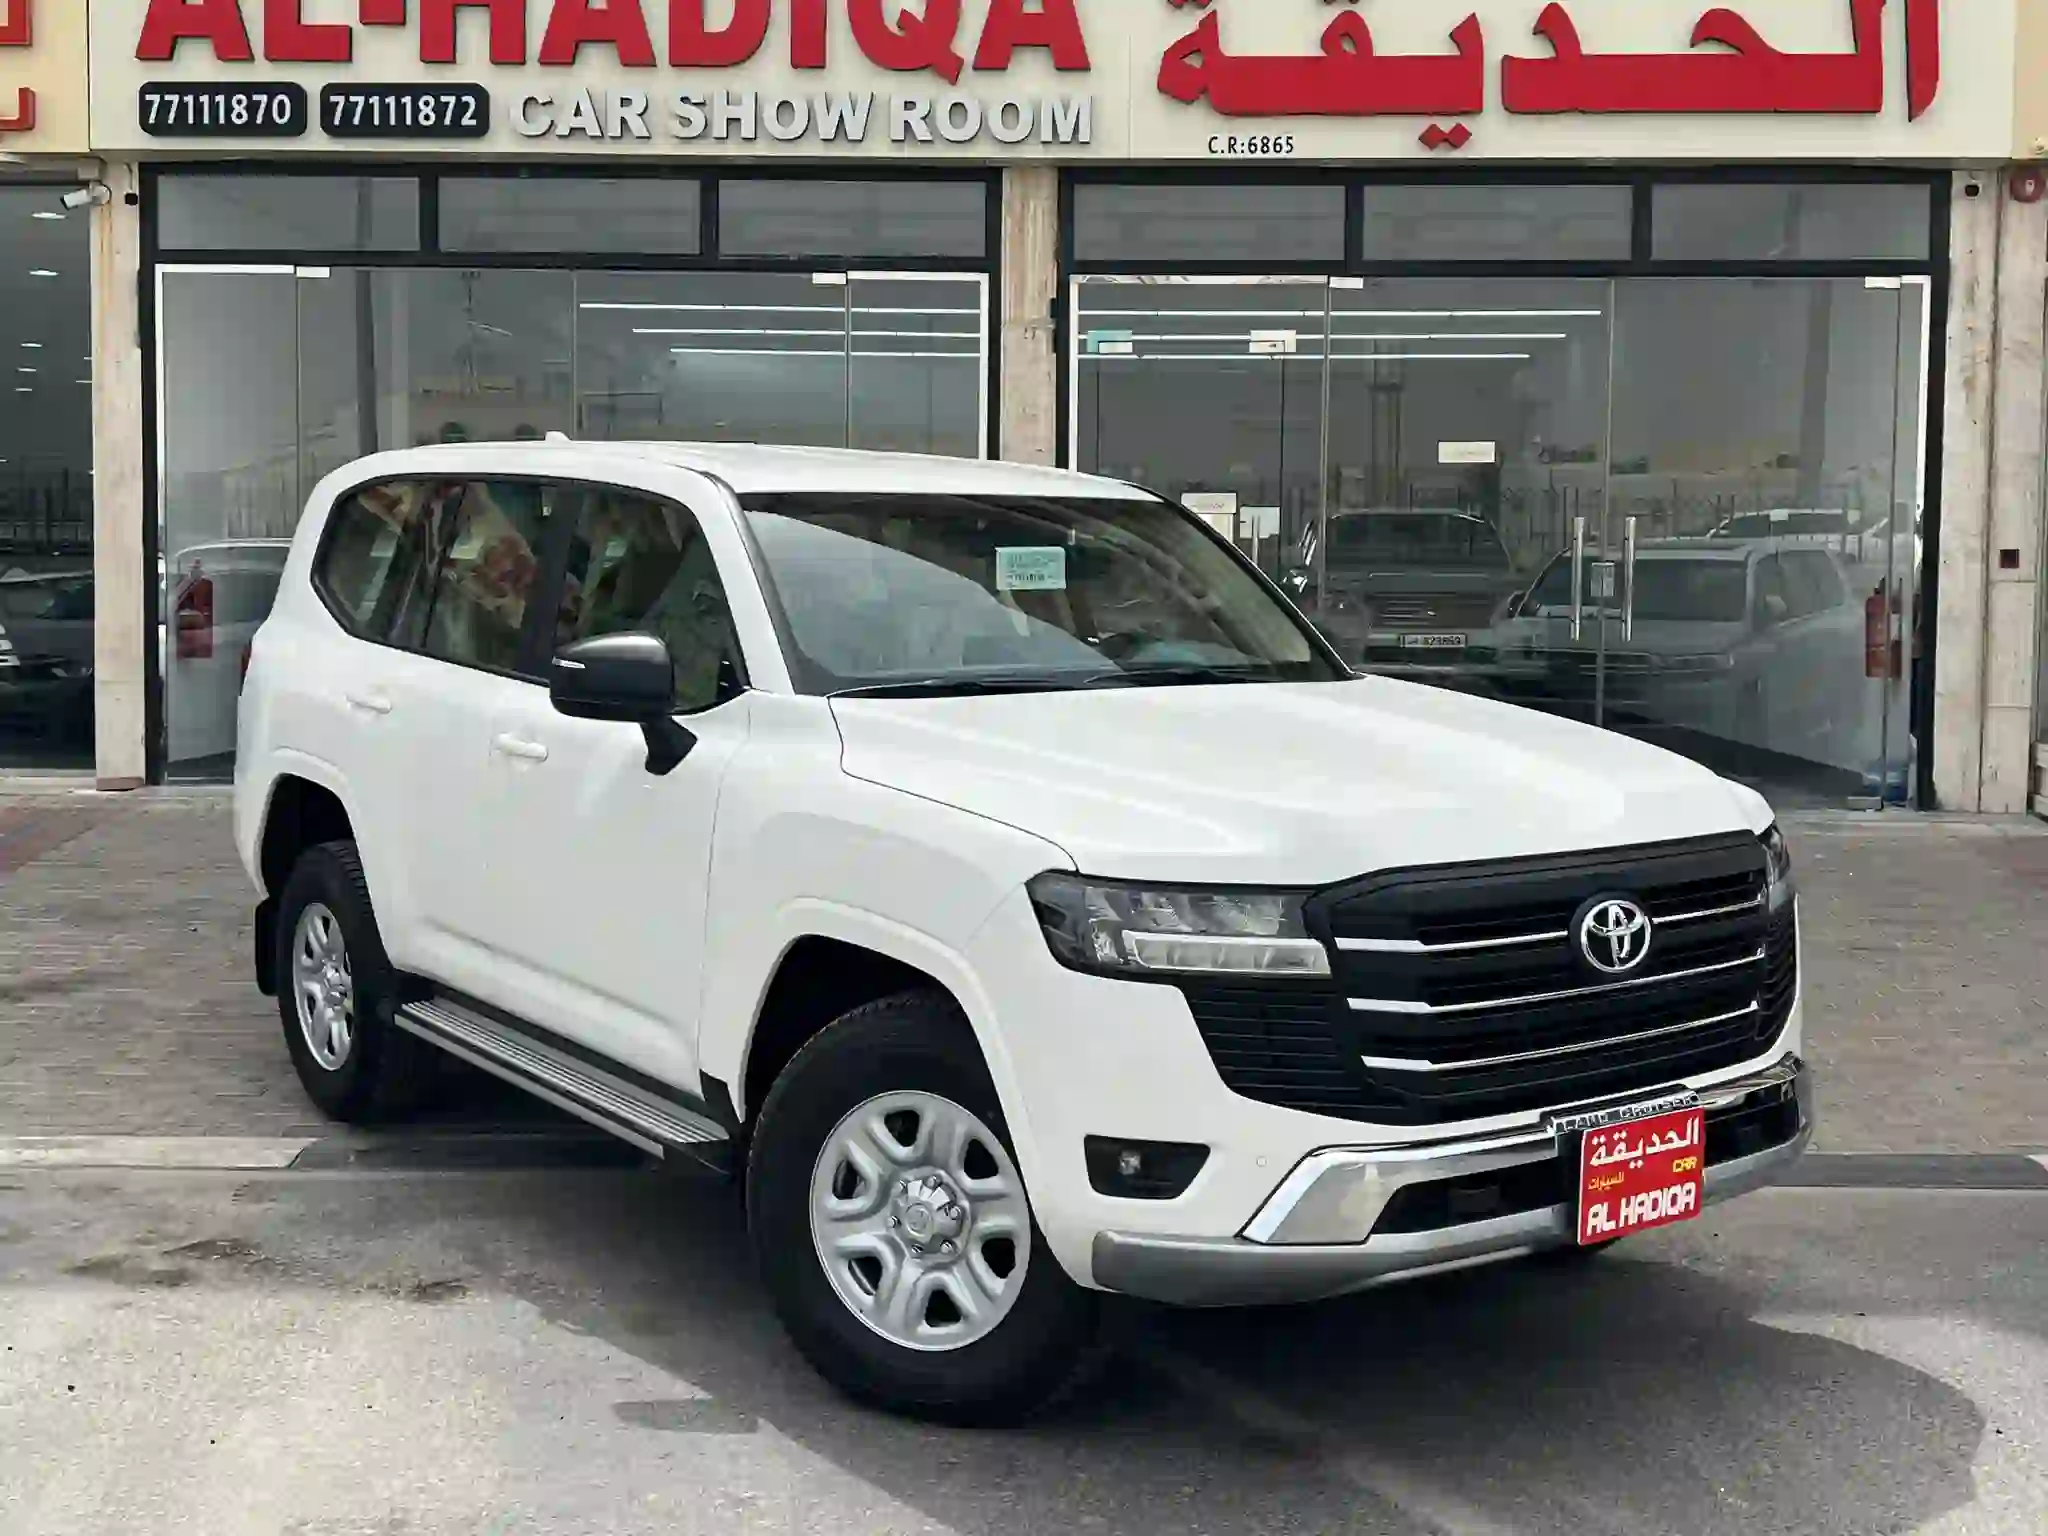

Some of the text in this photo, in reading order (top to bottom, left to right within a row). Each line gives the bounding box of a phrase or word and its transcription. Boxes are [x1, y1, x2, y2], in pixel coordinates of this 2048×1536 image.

[145, 94, 291, 124] 77111870
[330, 96, 477, 126] 77111872
[511, 88, 1091, 144] CAR SHOW ROOM
[1207, 135, 1295, 154] C.R:6865
[1589, 1116, 1699, 1169] الحديقة
[1672, 1156, 1698, 1172] CAR
[1587, 1202, 1616, 1236] AL
